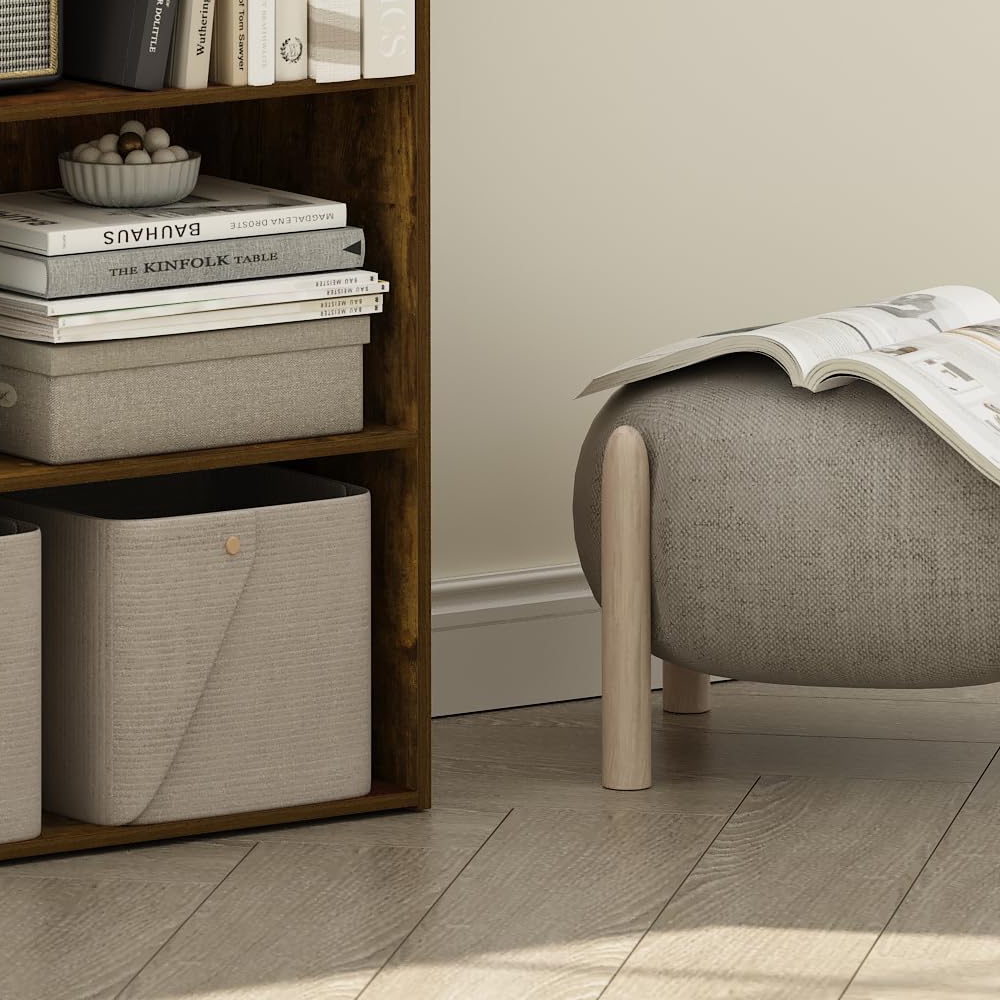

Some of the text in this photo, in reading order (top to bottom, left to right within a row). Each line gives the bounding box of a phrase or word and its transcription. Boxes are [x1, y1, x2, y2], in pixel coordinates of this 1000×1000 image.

[165, 0, 171, 8] OF
[148, 7, 162, 53] DOLITTLE
[236, 33, 245, 72] Sawyer
[103, 212, 335, 246] MAGDALENA DROSTE BAUHAUS
[109, 252, 278, 278] THE KINFOLK TABLE
[315, 279, 342, 287] MEISTER
[326, 288, 352, 296] MEISTER
[320, 300, 347, 308] MEISTER
[320, 306, 362, 316] BAU MEISTER
